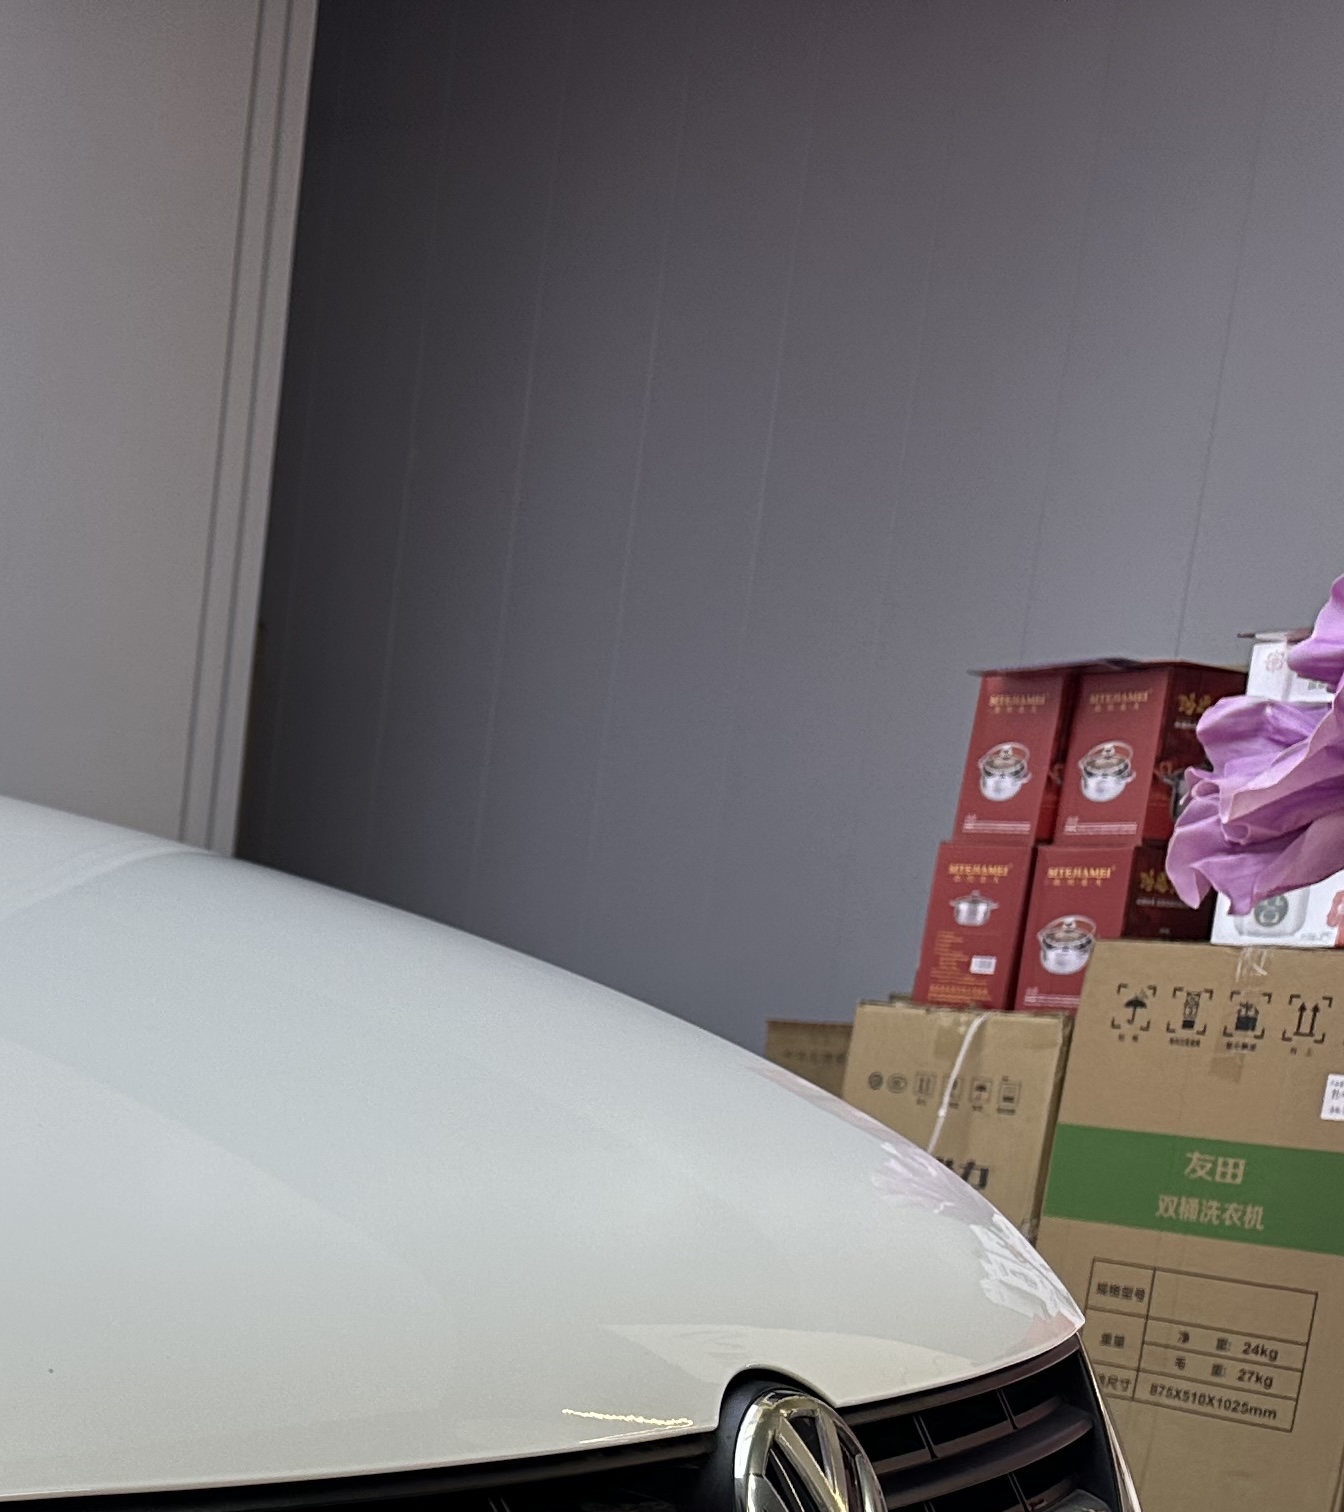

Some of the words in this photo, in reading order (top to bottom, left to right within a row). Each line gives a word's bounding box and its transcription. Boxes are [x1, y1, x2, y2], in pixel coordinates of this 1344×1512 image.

[1184, 1151, 1246, 1184] 友田
[1156, 1194, 1264, 1231] 双桶洗衣机
[1242, 1341, 1279, 1363] 24kg
[1236, 1367, 1274, 1390] 27kg
